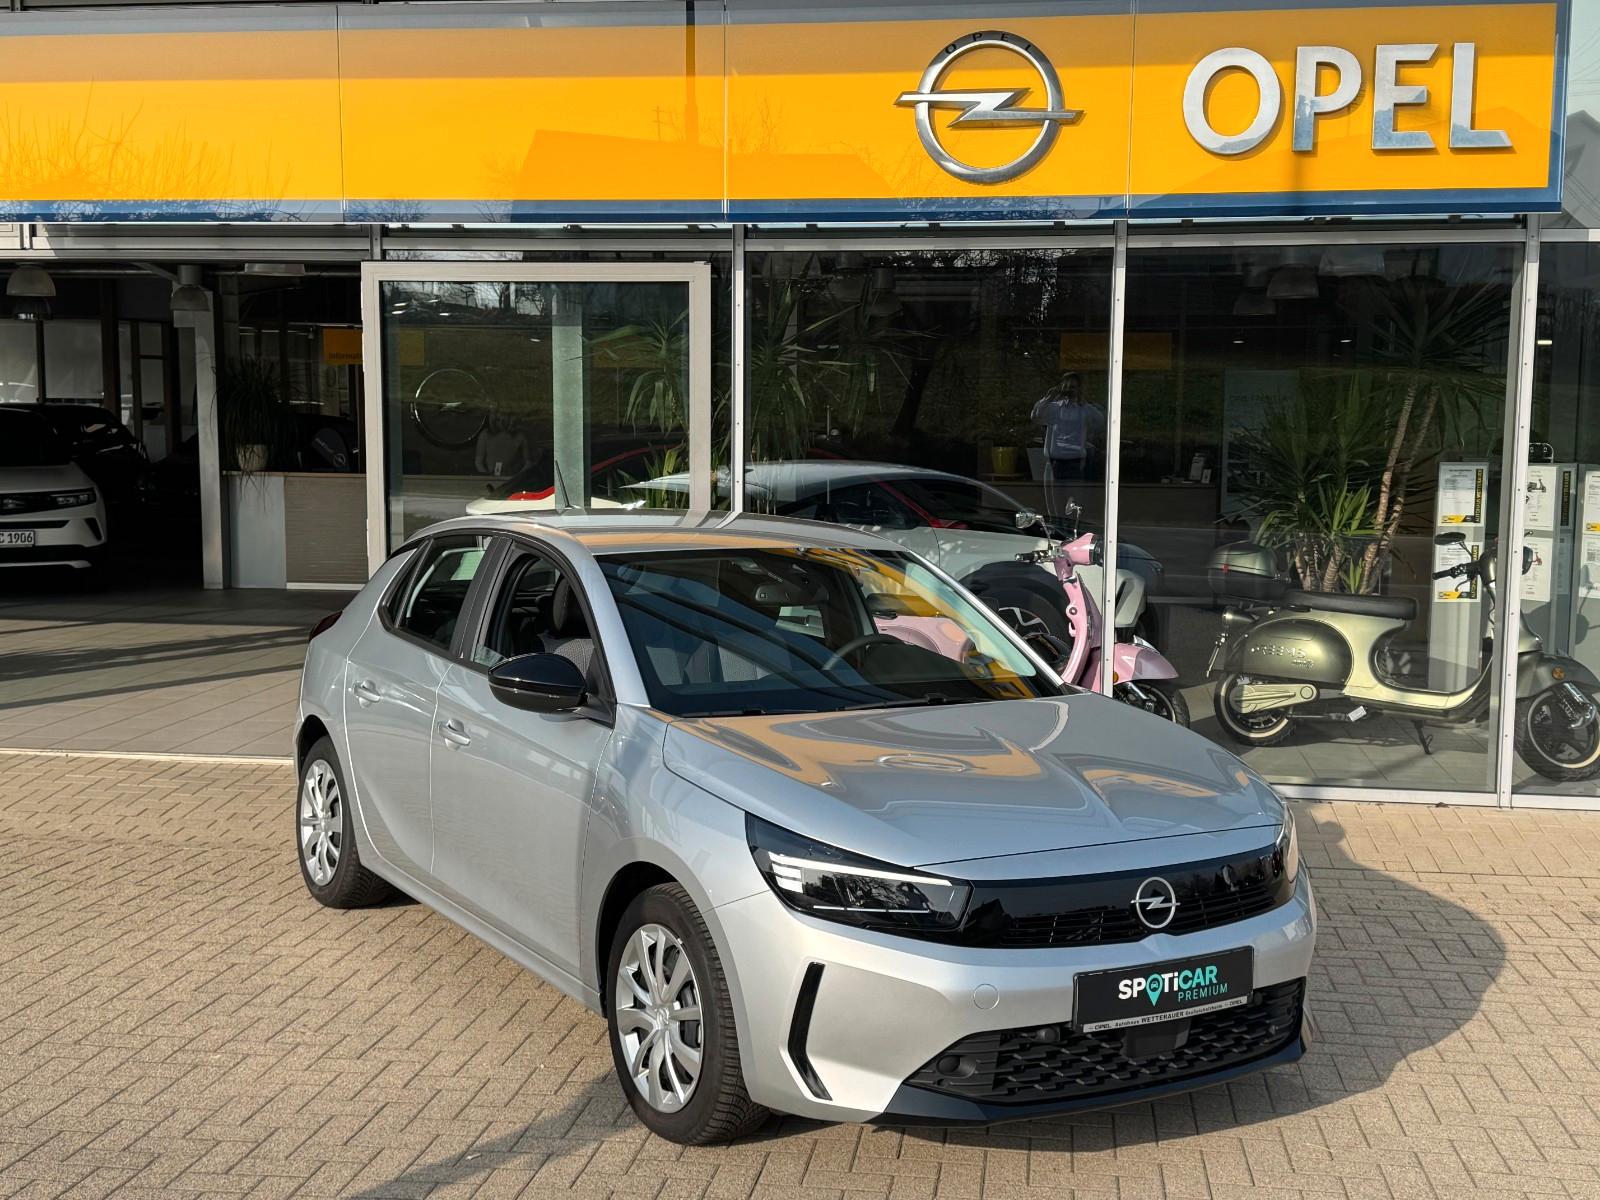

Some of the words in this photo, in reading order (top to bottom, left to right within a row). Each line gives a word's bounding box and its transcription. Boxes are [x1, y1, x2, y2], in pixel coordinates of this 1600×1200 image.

[945, 32, 1034, 55] OPEL
[1182, 42, 1512, 155] OPEL
[7, 532, 33, 543] 1906
[1178, 983, 1228, 1002] PREMIUM
[1114, 1019, 1140, 1028] Autohaus
[1141, 1011, 1184, 1023] WETTERAUER
